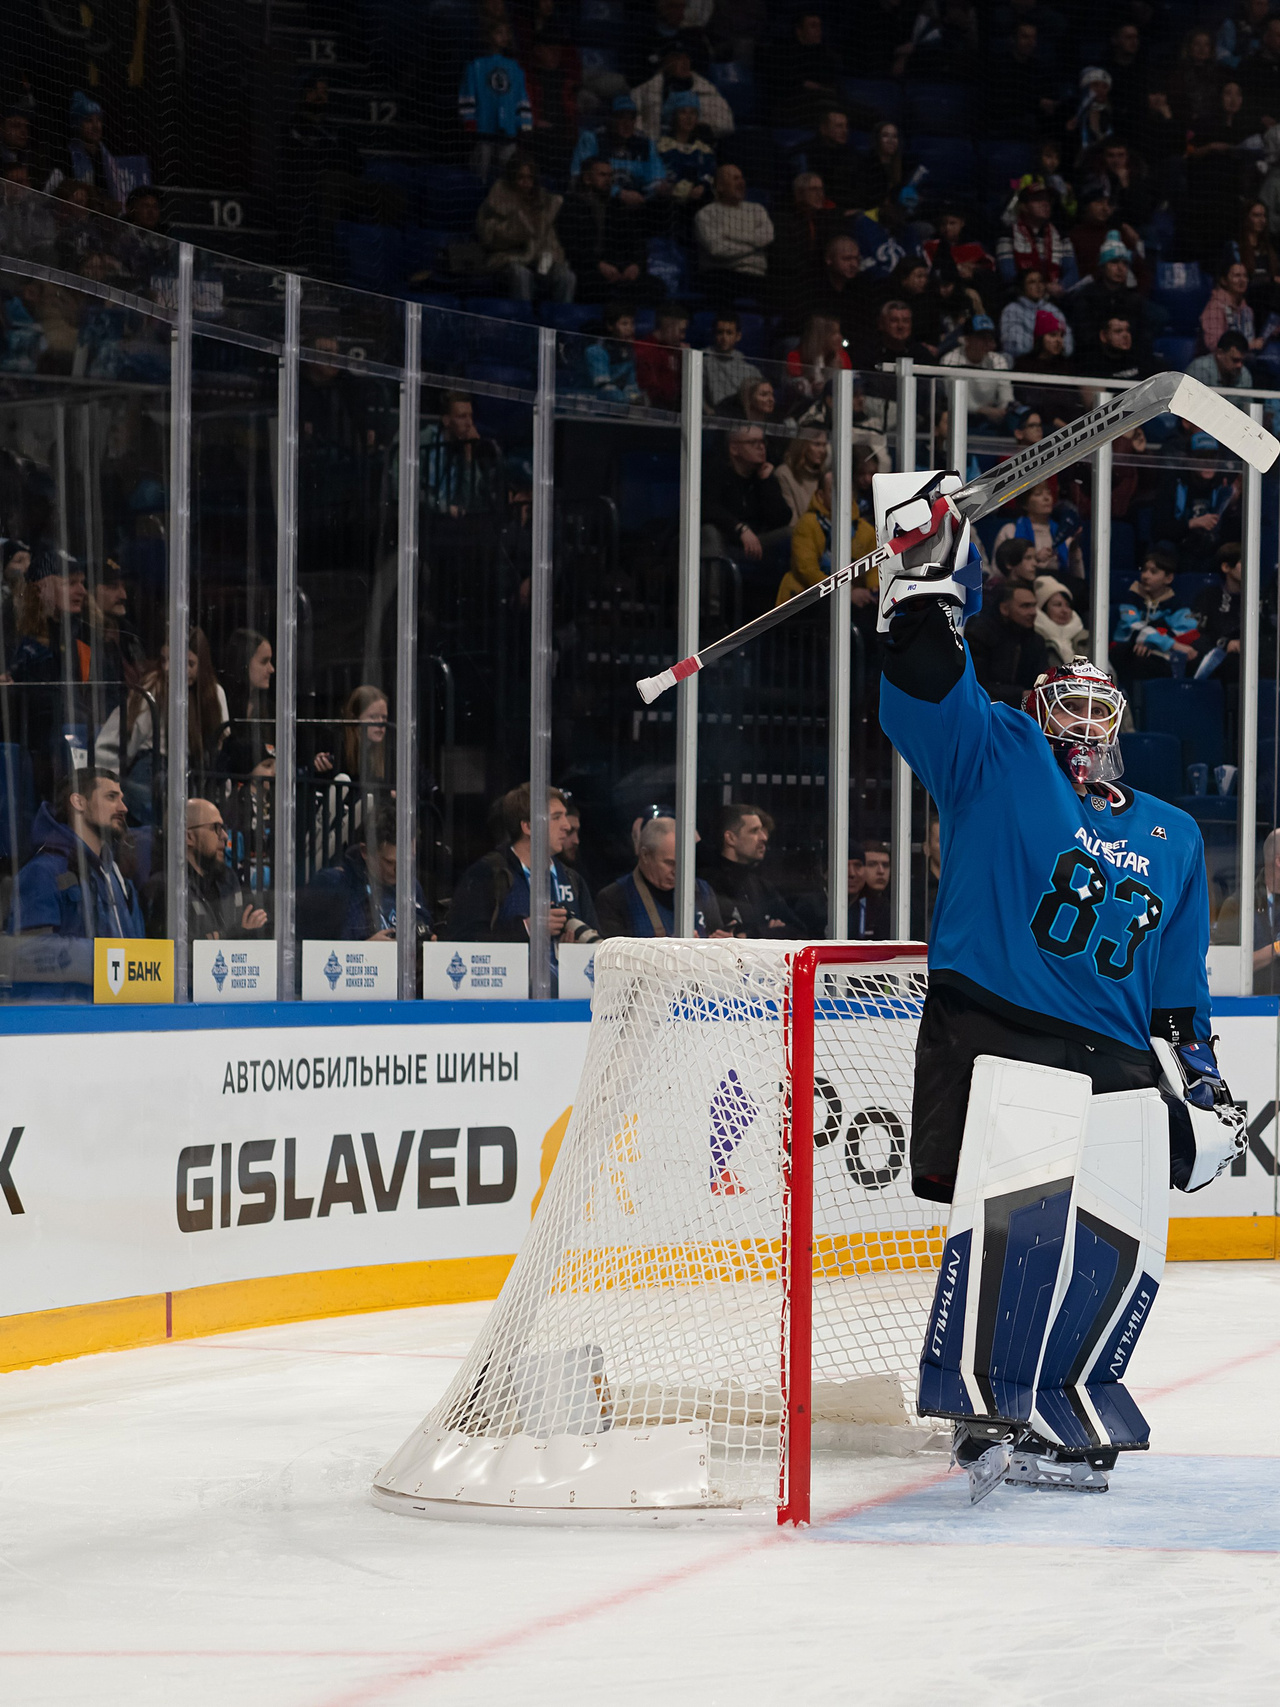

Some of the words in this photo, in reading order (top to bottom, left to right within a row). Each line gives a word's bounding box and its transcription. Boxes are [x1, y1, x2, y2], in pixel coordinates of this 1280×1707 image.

[369, 101, 398, 124] 12
[210, 199, 244, 228] 10
[1029, 846, 1164, 983] 83
[128, 961, 162, 982] БАНК
[222, 1053, 427, 1095] АВТОМОБИЛЬНЫЕ
[436, 1051, 520, 1085] ШИНЫ
[176, 1126, 518, 1234] GISLAVED
